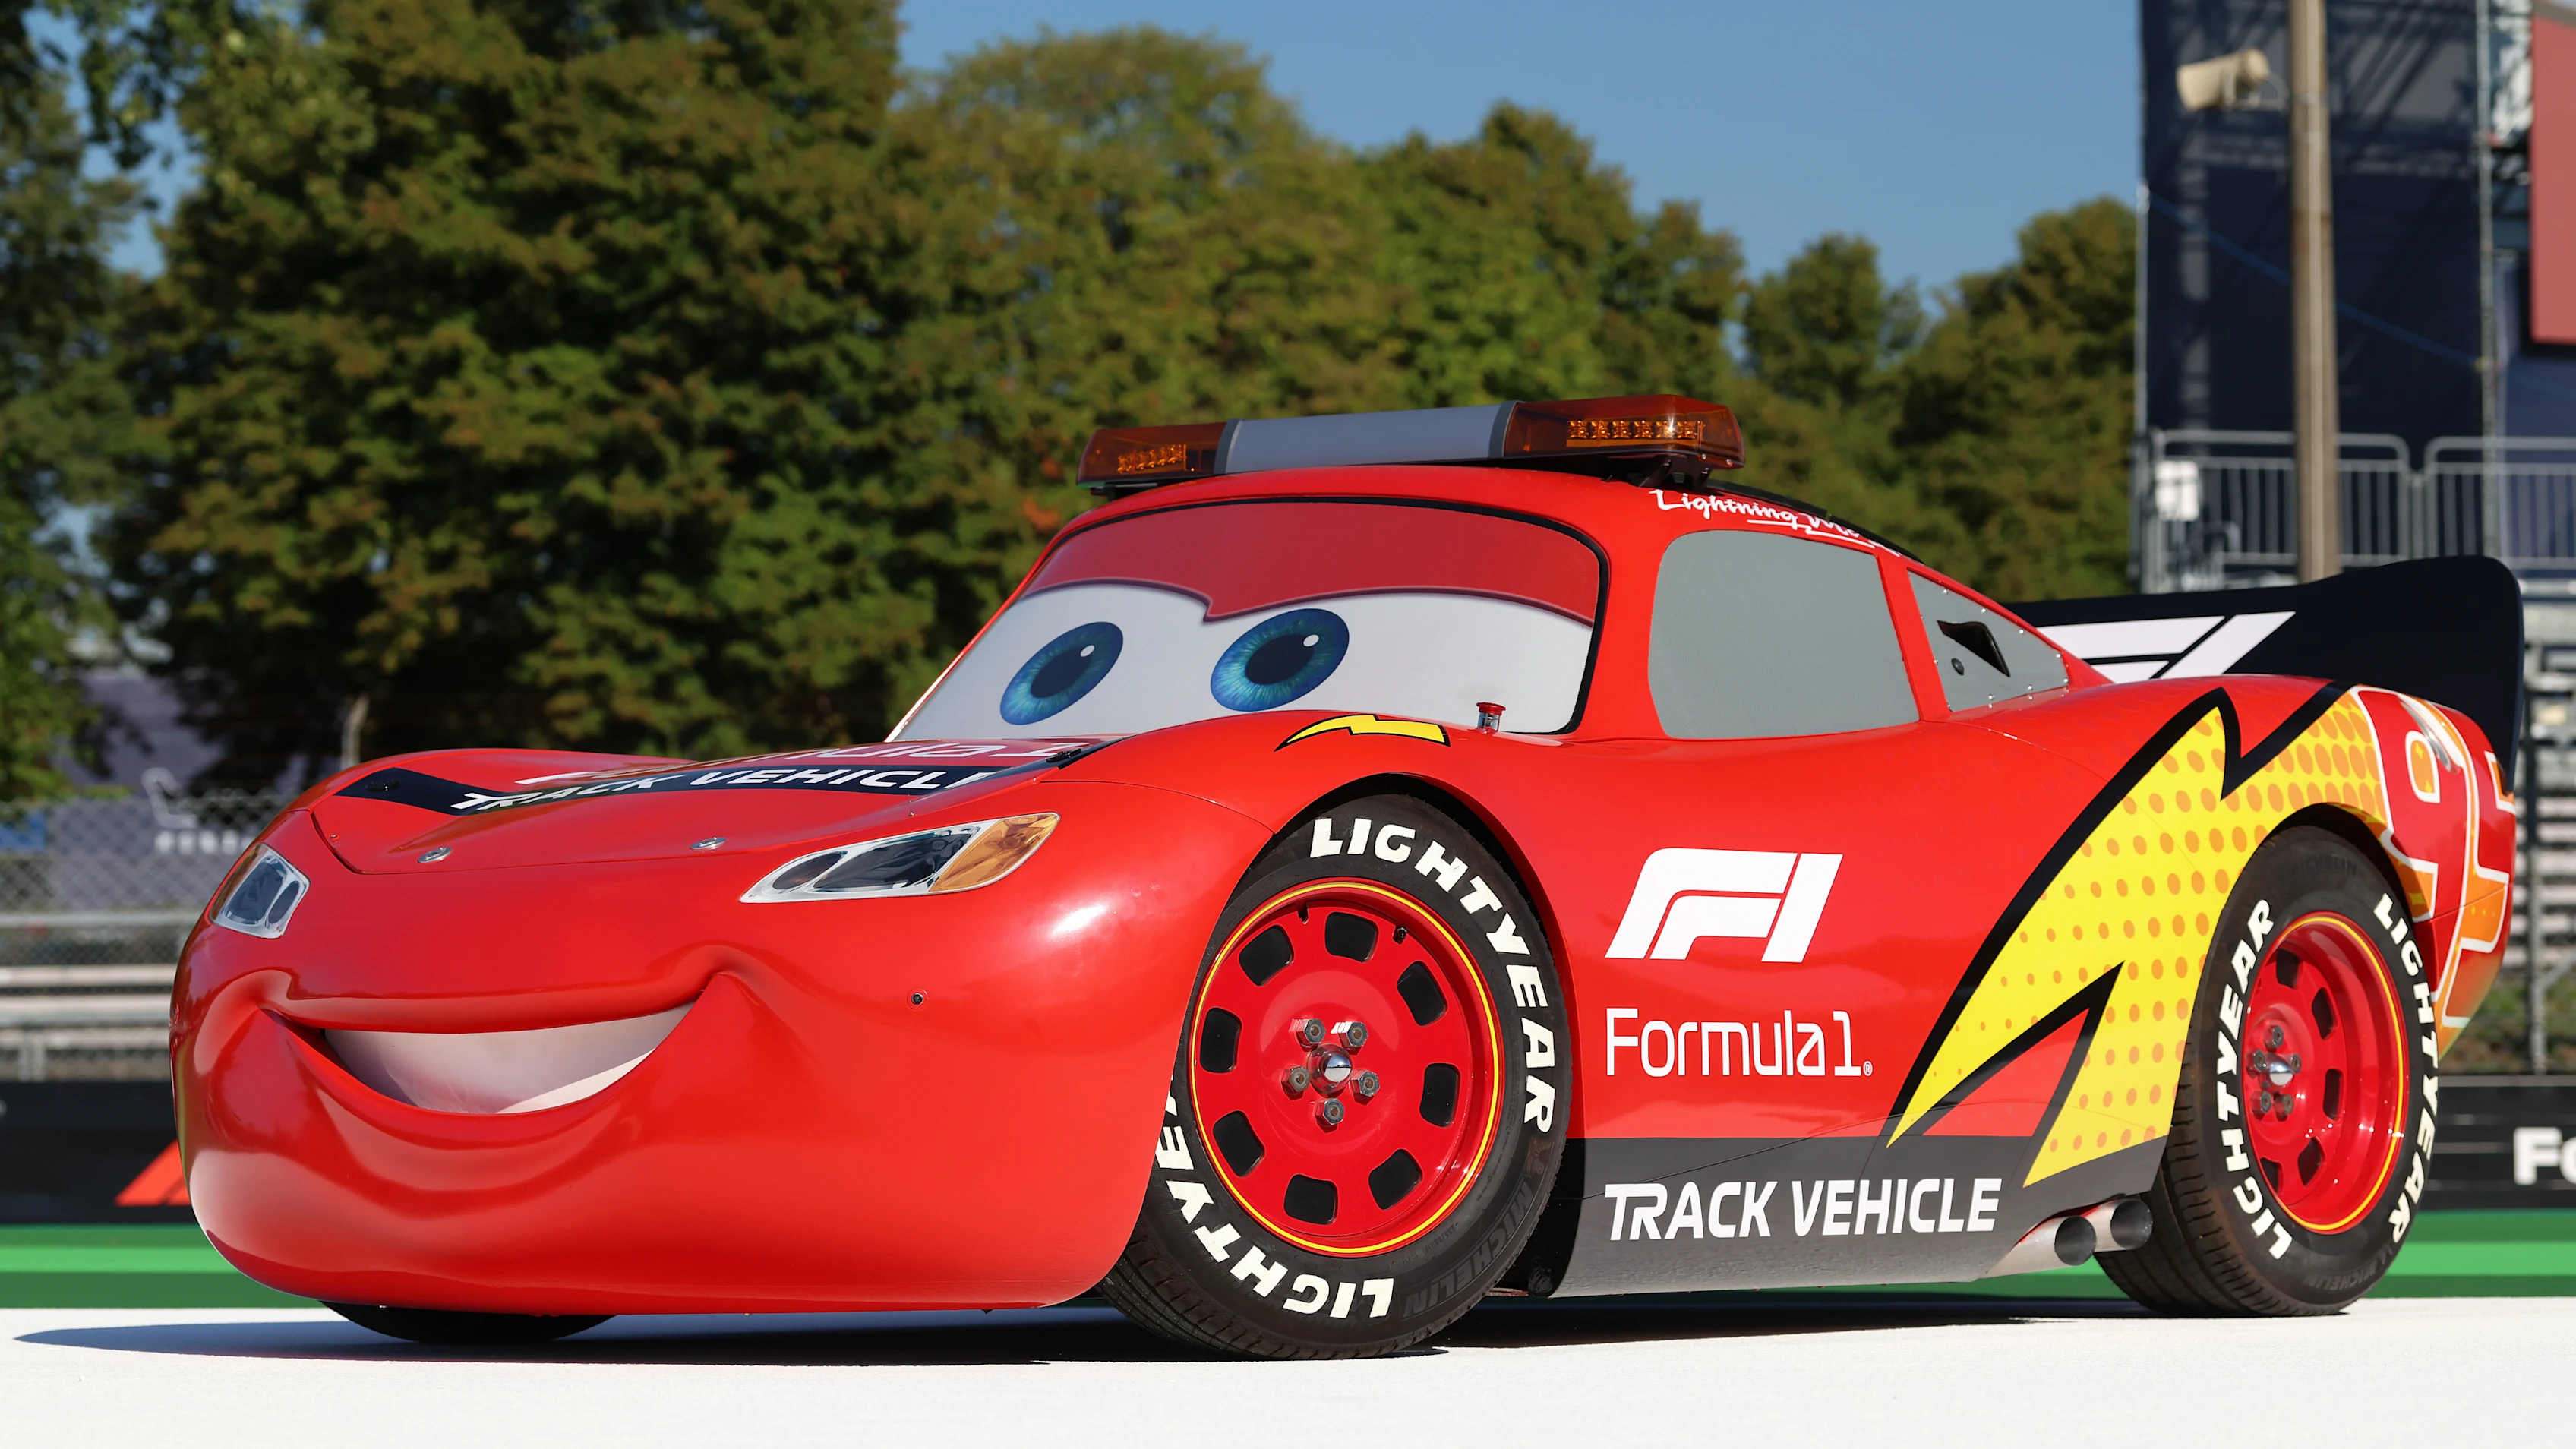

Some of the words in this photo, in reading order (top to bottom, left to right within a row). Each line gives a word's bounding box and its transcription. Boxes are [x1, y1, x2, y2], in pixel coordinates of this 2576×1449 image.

[1649, 489, 1799, 531] Lightning
[451, 774, 687, 810] TRACK
[1604, 848, 1844, 963] F1
[1309, 817, 1556, 1134] LIGHTYEAR
[2217, 899, 2293, 1260] LIGHTYEAR
[2373, 893, 2439, 1243] LIGHTYEAR
[1604, 1181, 1779, 1241] TRACK
[1792, 1178, 2003, 1237] VEHICLE
